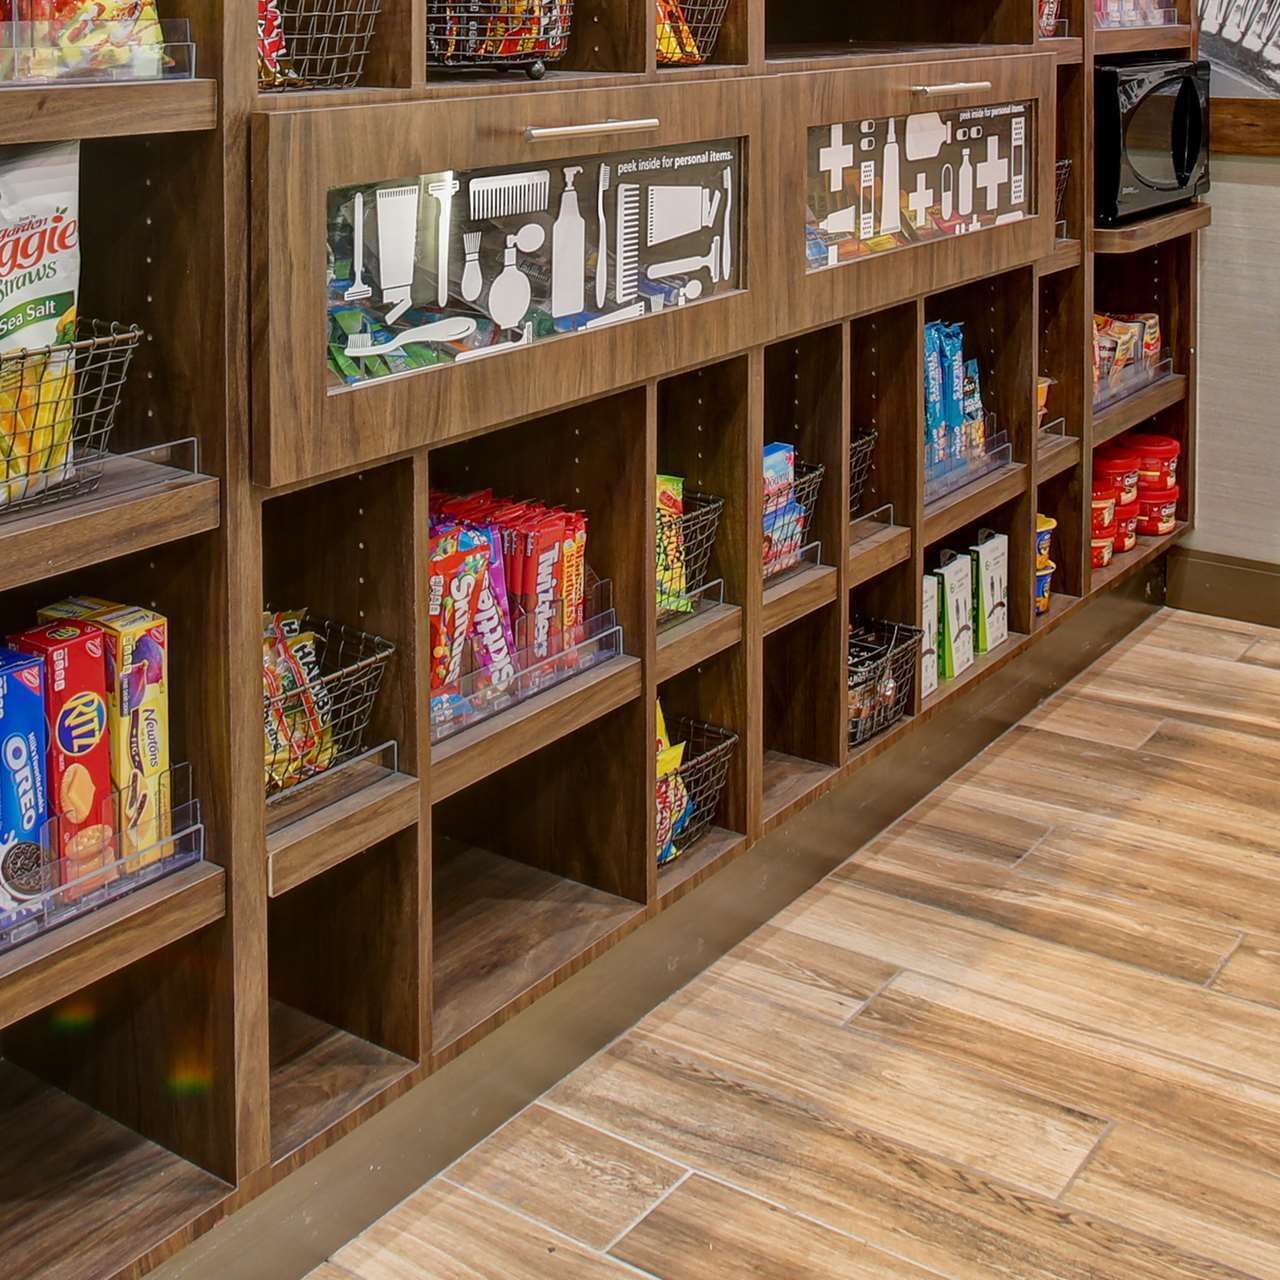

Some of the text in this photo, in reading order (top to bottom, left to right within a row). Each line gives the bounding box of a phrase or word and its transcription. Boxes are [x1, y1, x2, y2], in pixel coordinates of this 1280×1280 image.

[617, 160, 637, 176] peek
[638, 157, 661, 171] inside
[662, 155, 674, 168] for
[674, 150, 709, 169] personal
[25, 300, 58, 323] Salt
[534, 541, 561, 658] Twizzlers
[142, 707, 159, 768] Newtons
[3, 733, 36, 831] OREO
